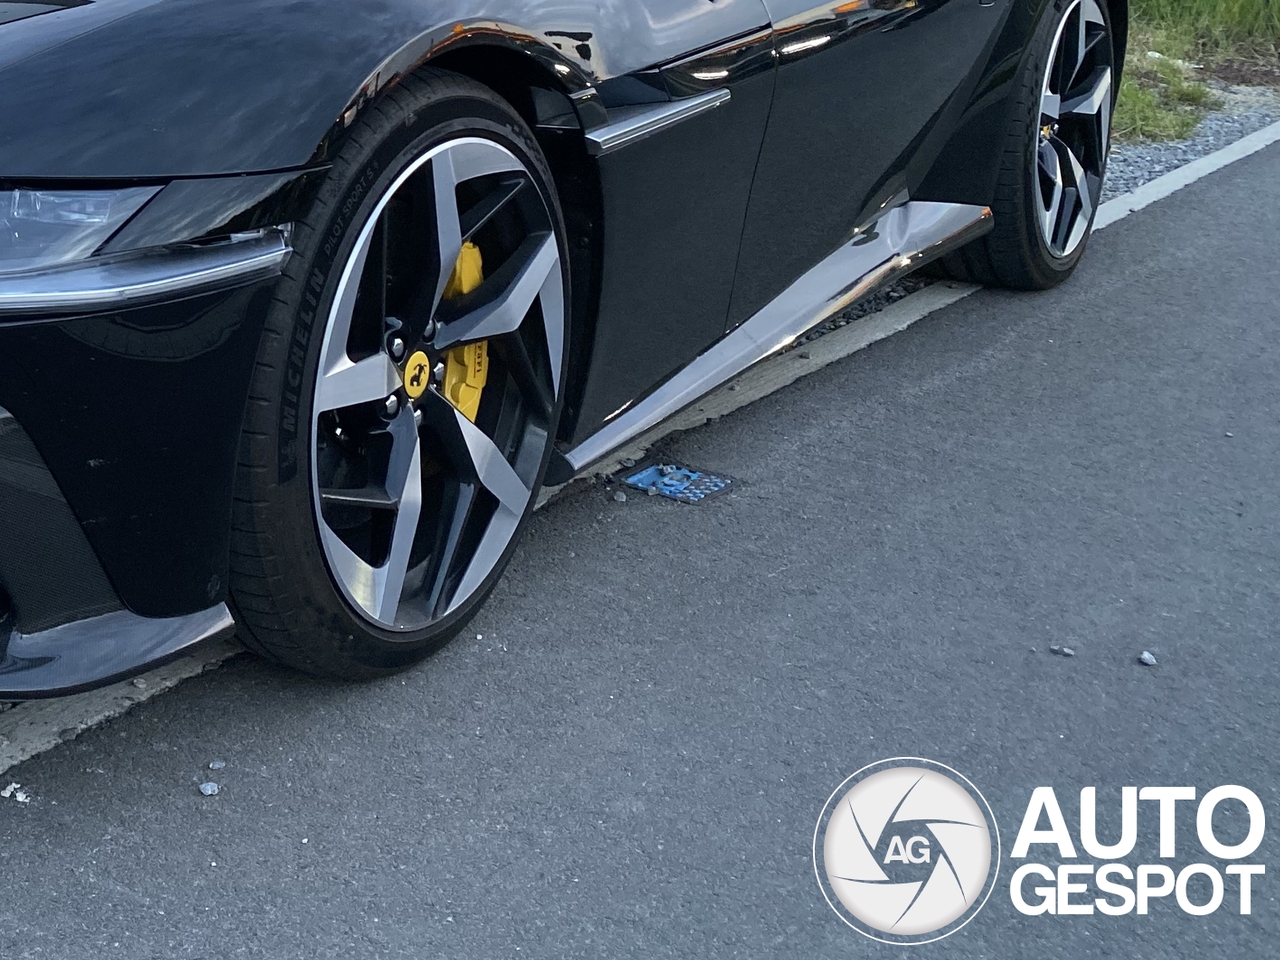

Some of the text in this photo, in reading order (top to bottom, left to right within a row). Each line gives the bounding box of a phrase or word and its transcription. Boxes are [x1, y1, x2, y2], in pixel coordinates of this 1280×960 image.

[324, 219, 344, 256] PILOT
[342, 175, 369, 215] SPORT
[283, 268, 325, 431] MICHELIN
